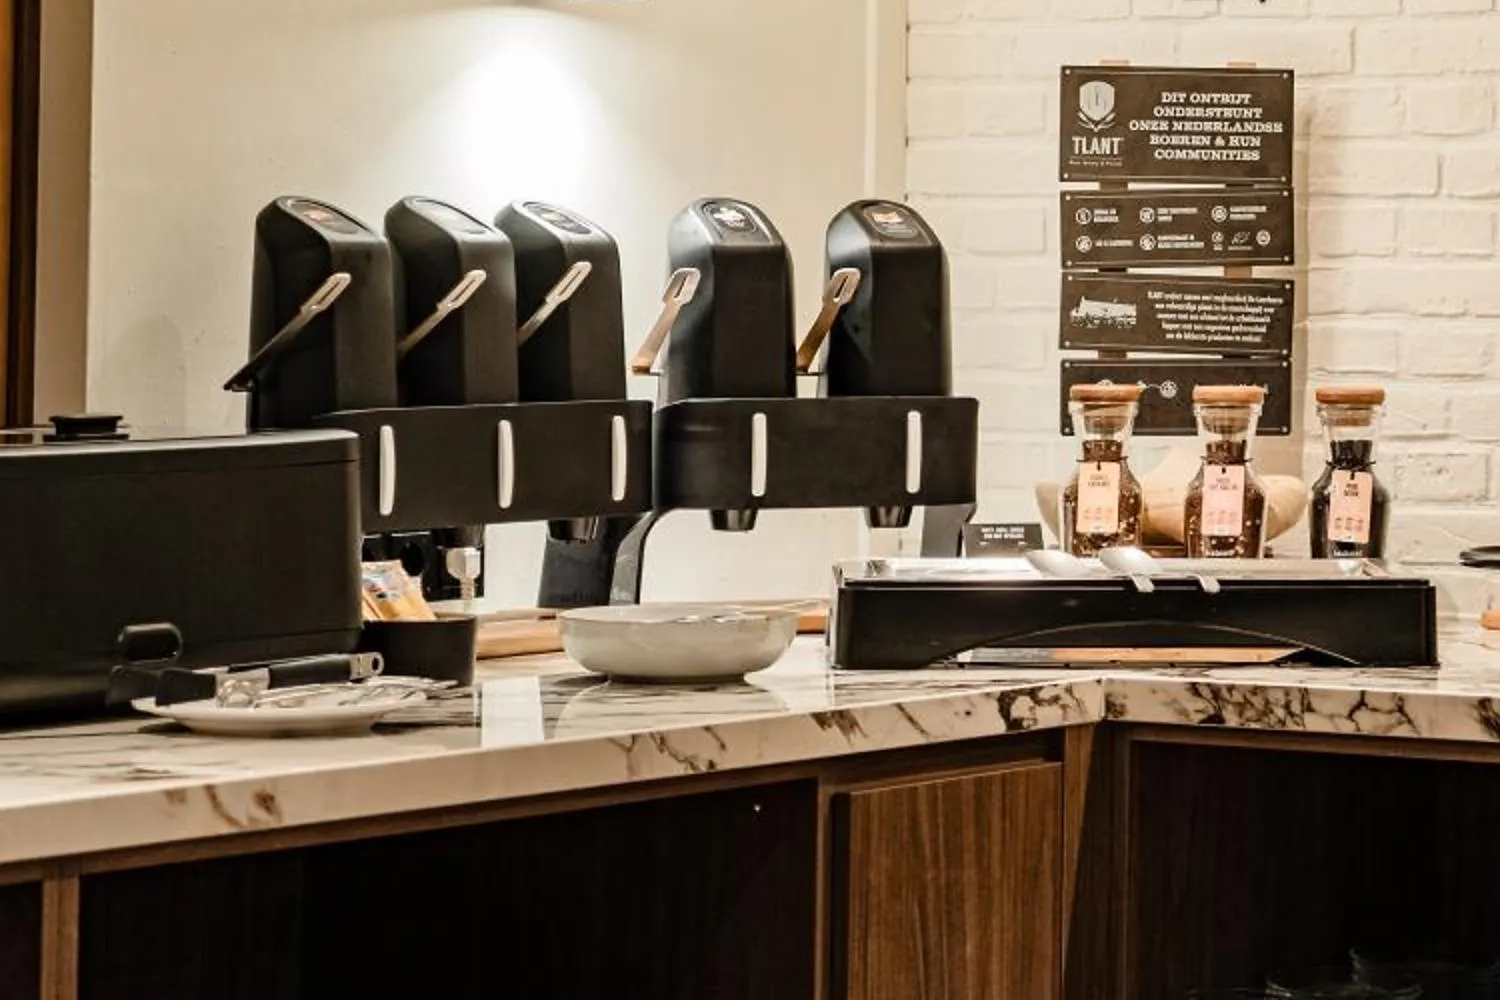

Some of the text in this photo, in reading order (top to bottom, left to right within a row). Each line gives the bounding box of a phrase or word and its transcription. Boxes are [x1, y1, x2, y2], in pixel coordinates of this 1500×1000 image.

[1161, 92, 1186, 103] DIT
[1153, 106, 1263, 119] ONDERSTEUNT
[1129, 120, 1283, 133] ONZE NEDERLANDSE
[1071, 135, 1125, 155] TLANT
[1214, 136, 1225, 146] &
[1228, 135, 1261, 147] HUN
[1154, 149, 1261, 161] COMMUNITIES
